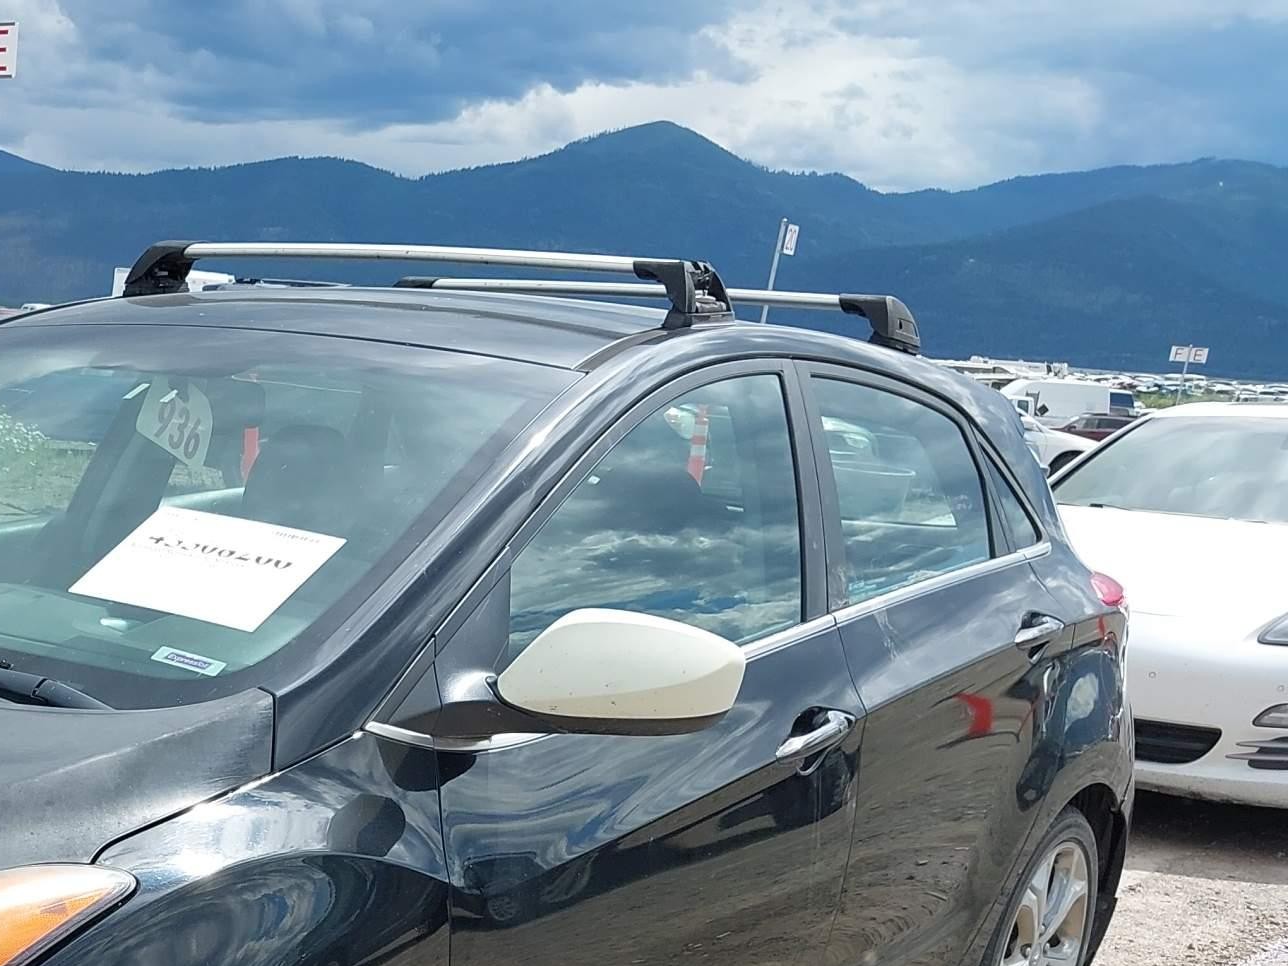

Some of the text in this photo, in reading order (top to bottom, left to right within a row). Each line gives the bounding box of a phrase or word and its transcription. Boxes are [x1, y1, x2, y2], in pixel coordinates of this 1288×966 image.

[1174, 347, 1204, 362] F E
[153, 399, 201, 460] 936
